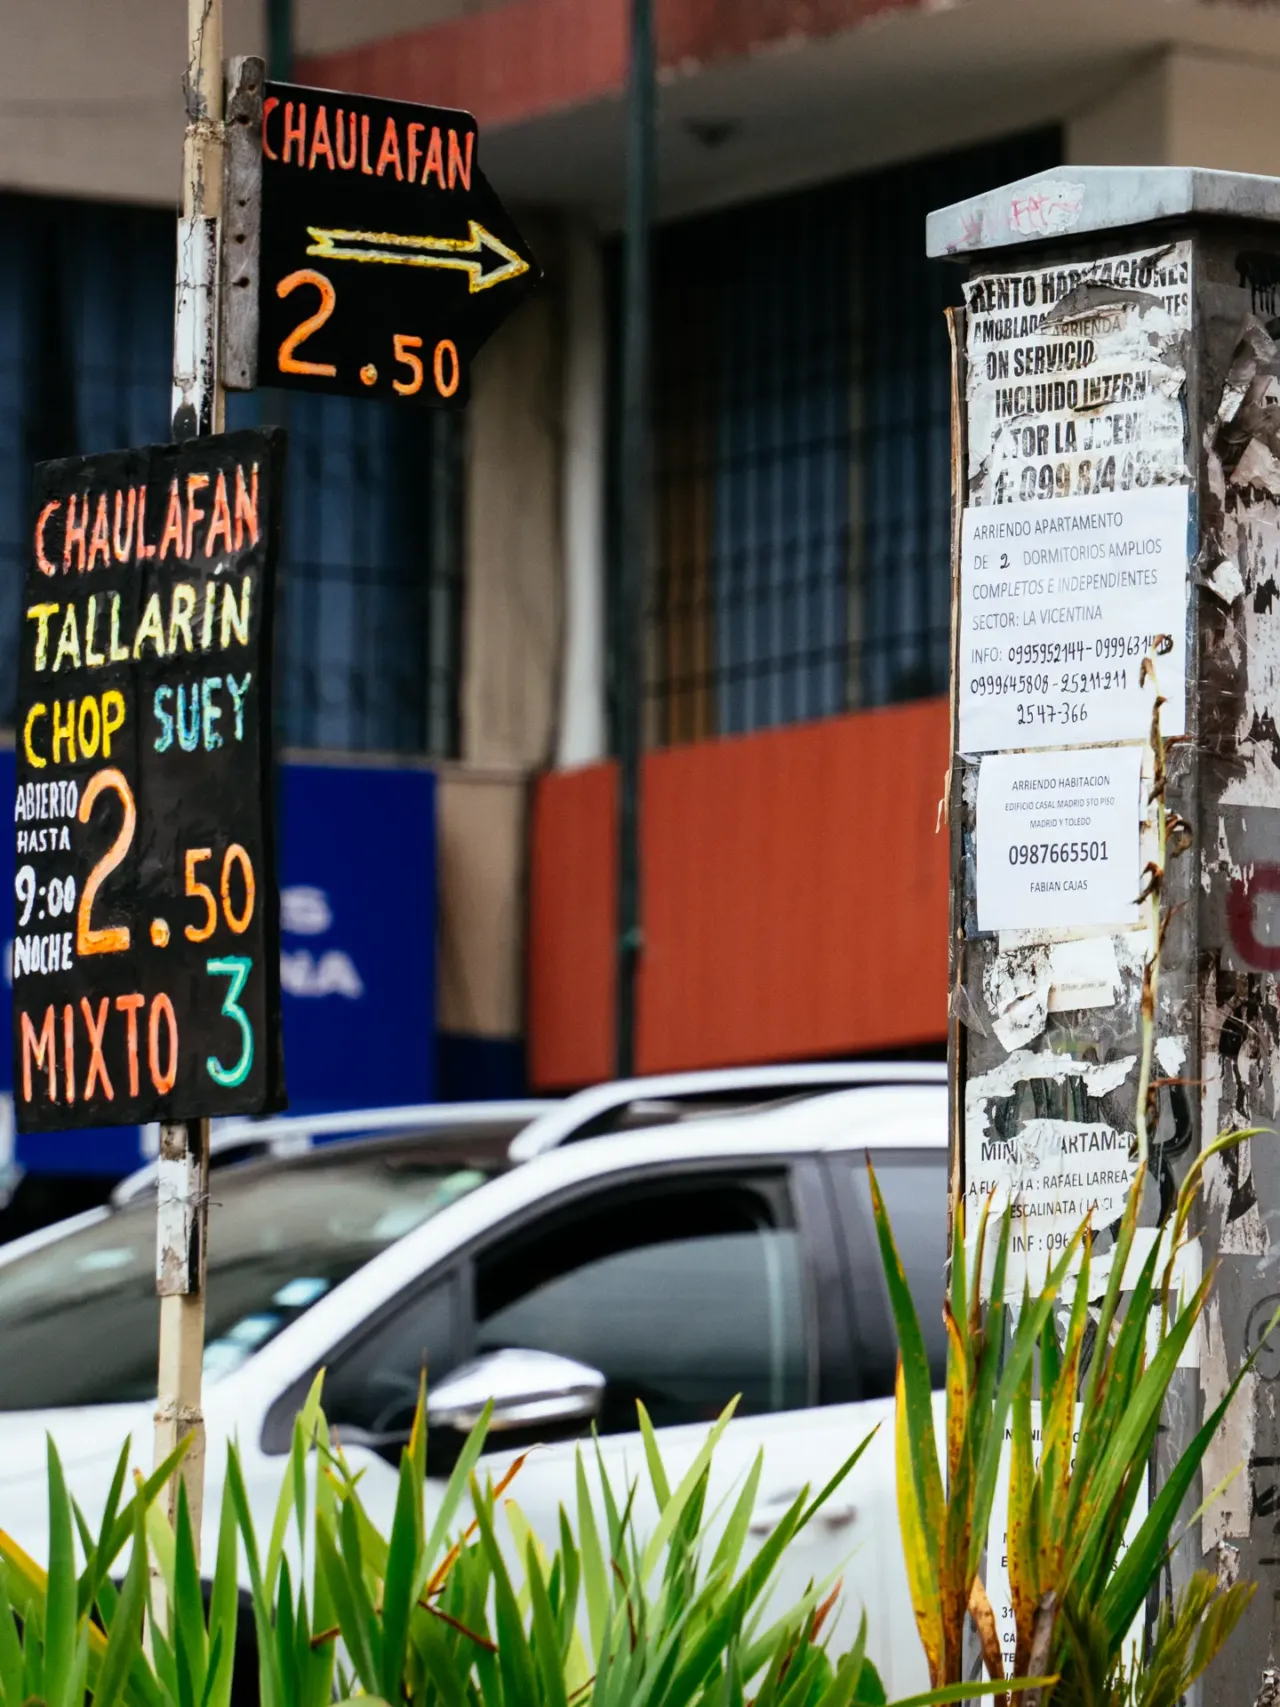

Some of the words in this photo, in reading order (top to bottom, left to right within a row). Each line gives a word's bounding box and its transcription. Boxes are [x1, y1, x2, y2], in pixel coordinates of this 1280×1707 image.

[262, 97, 475, 191] CHAULAFAN
[969, 276, 1036, 314] RENTO
[1013, 340, 1096, 377] SERVICIO
[995, 379, 1078, 419] INCLUIDO
[1055, 421, 1078, 454] LA
[35, 462, 260, 577] CHAULAFAN
[973, 520, 1031, 540] ARRIENDO
[1034, 511, 1124, 535] APARTAMENTO
[974, 554, 989, 570] DE
[999, 553, 1010, 570] 2
[1023, 543, 1106, 566] DORMITORIOS
[1108, 538, 1162, 557] AMPLIOS
[972, 579, 1044, 600] COMPLETOS
[1047, 578, 1055, 594] E
[1057, 569, 1158, 593] INDEPENDIENTES
[972, 612, 1019, 631] SECTOR:
[1023, 610, 1036, 626] LA
[1039, 604, 1102, 624] VICENTINA
[971, 647, 1002, 664] INFO:
[24, 689, 126, 768] CHOP
[154, 672, 252, 753] SUEY
[1012, 778, 1057, 791] ARRIENDO
[1059, 775, 1110, 789] HABITACION
[14, 780, 78, 822] ABIERTO
[1005, 801, 1034, 811] EDIFICIO
[1057, 798, 1085, 808] MADRID
[1030, 818, 1057, 829] MADRID
[1065, 817, 1091, 827] TOLEDO
[17, 826, 71, 853] HASTA
[1008, 840, 1108, 865] 0987665501
[14, 865, 77, 926] 9:00
[1030, 881, 1061, 893] FABIAN
[1063, 879, 1088, 891] CAJAS
[14, 933, 73, 978] NOCHE
[21, 992, 179, 1103] MIXTO
[206, 955, 254, 1087] 3
[1043, 1174, 1083, 1190] RAFAEL
[1086, 1170, 1128, 1185] LARREA
[1010, 1200, 1076, 1219] ESCALINATA
